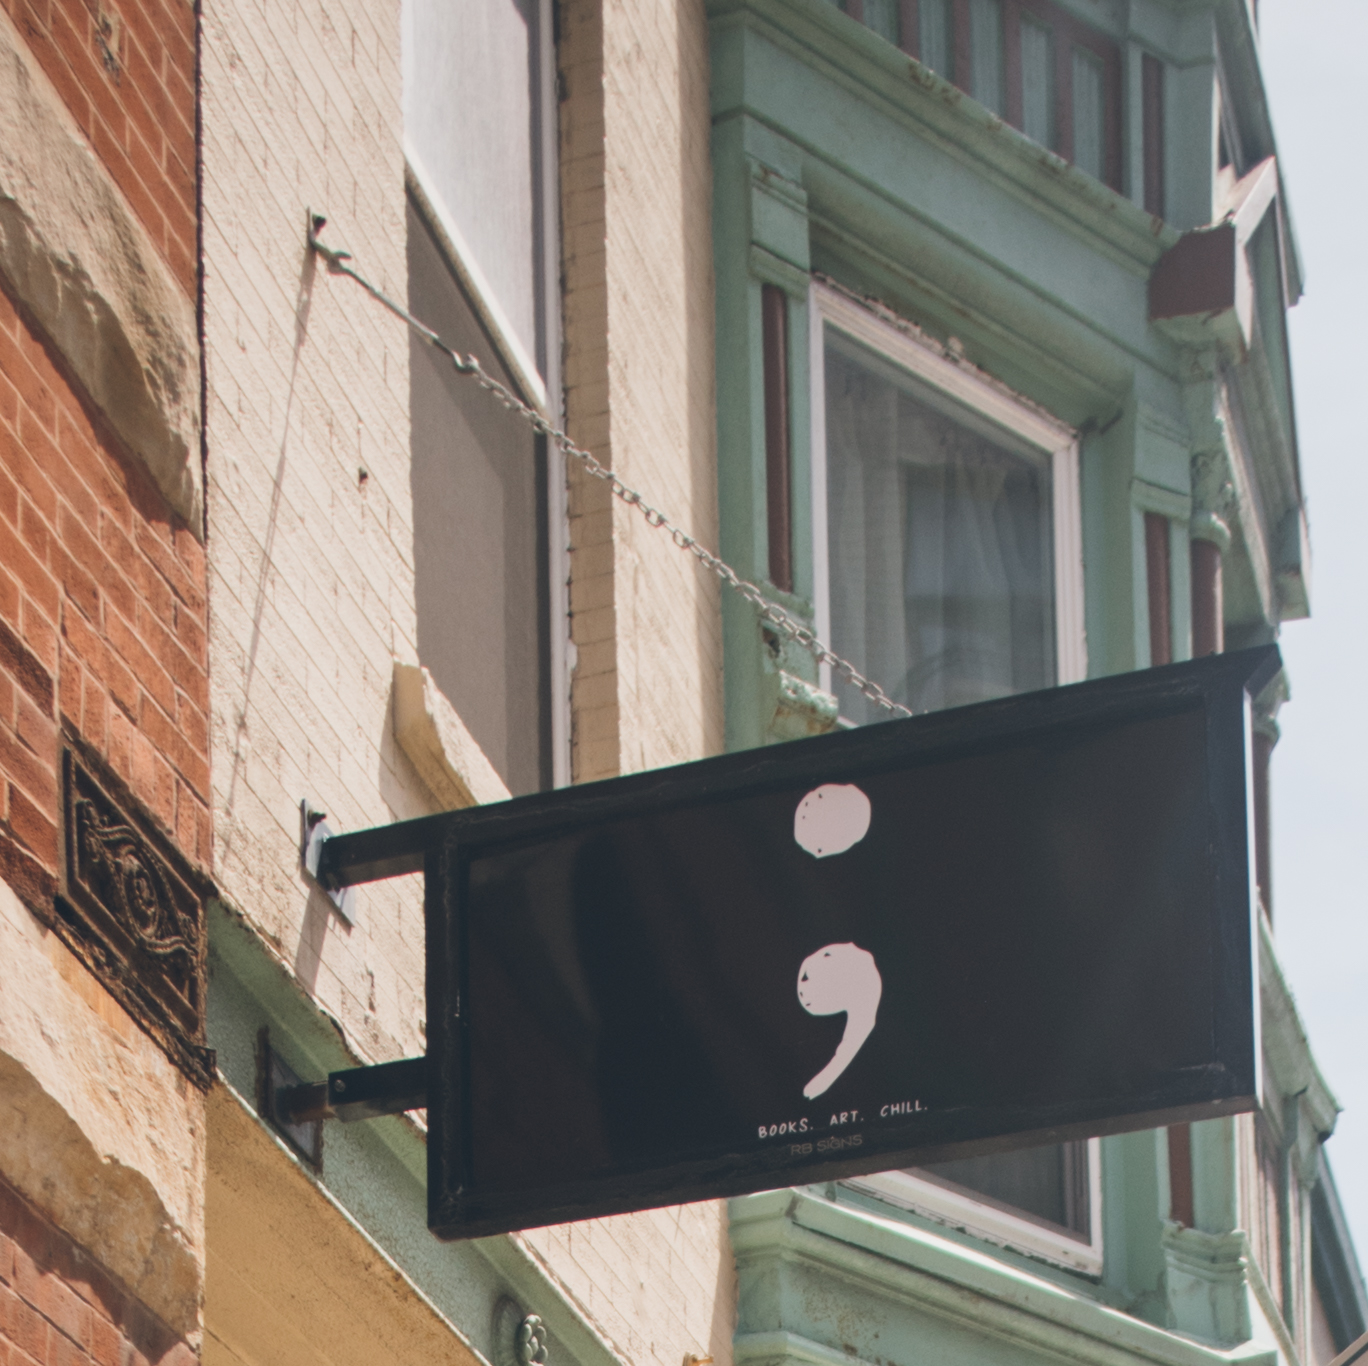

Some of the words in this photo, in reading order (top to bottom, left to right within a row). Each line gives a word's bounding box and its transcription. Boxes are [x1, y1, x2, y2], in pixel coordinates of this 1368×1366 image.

[758, 1118, 814, 1139] BOOKS.
[830, 1110, 865, 1126] ART.
[880, 1099, 929, 1118] CHILL.
[789, 1143, 814, 1156] RB
[816, 1133, 863, 1152] SIGNS
